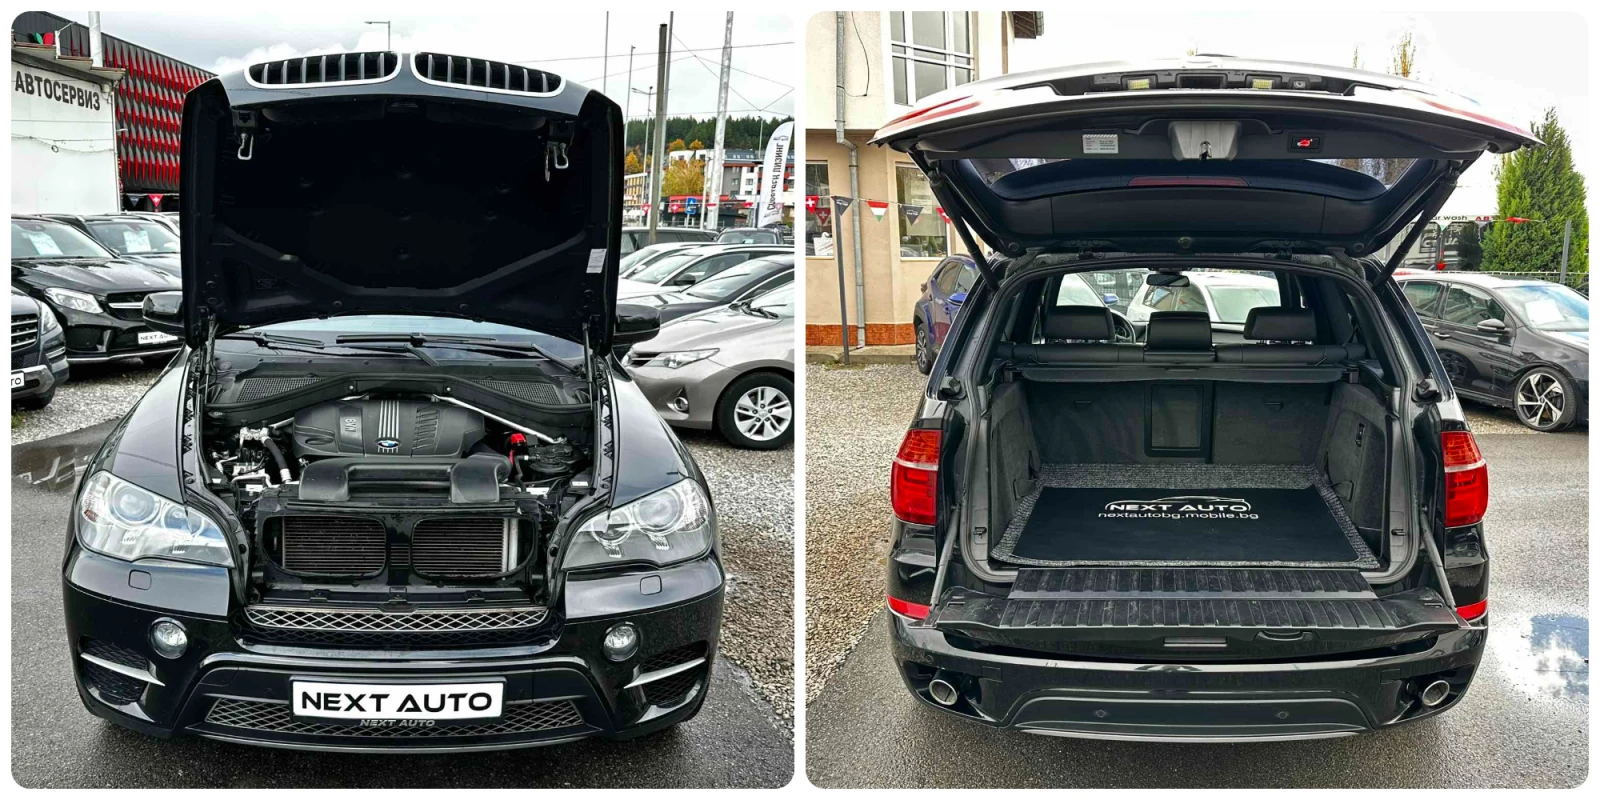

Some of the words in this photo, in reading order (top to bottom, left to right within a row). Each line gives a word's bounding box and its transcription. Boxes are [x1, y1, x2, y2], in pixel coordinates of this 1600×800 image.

[15, 71, 100, 111] АВТОСЕРВИЗ
[1178, 504, 1248, 512] AUTO
[1098, 512, 1259, 520] nextautobg.mobile.bg
[302, 691, 390, 713] NEXT
[396, 692, 492, 713] AUTO
[360, 719, 397, 727] NEXT
[398, 719, 436, 727] AUTO
